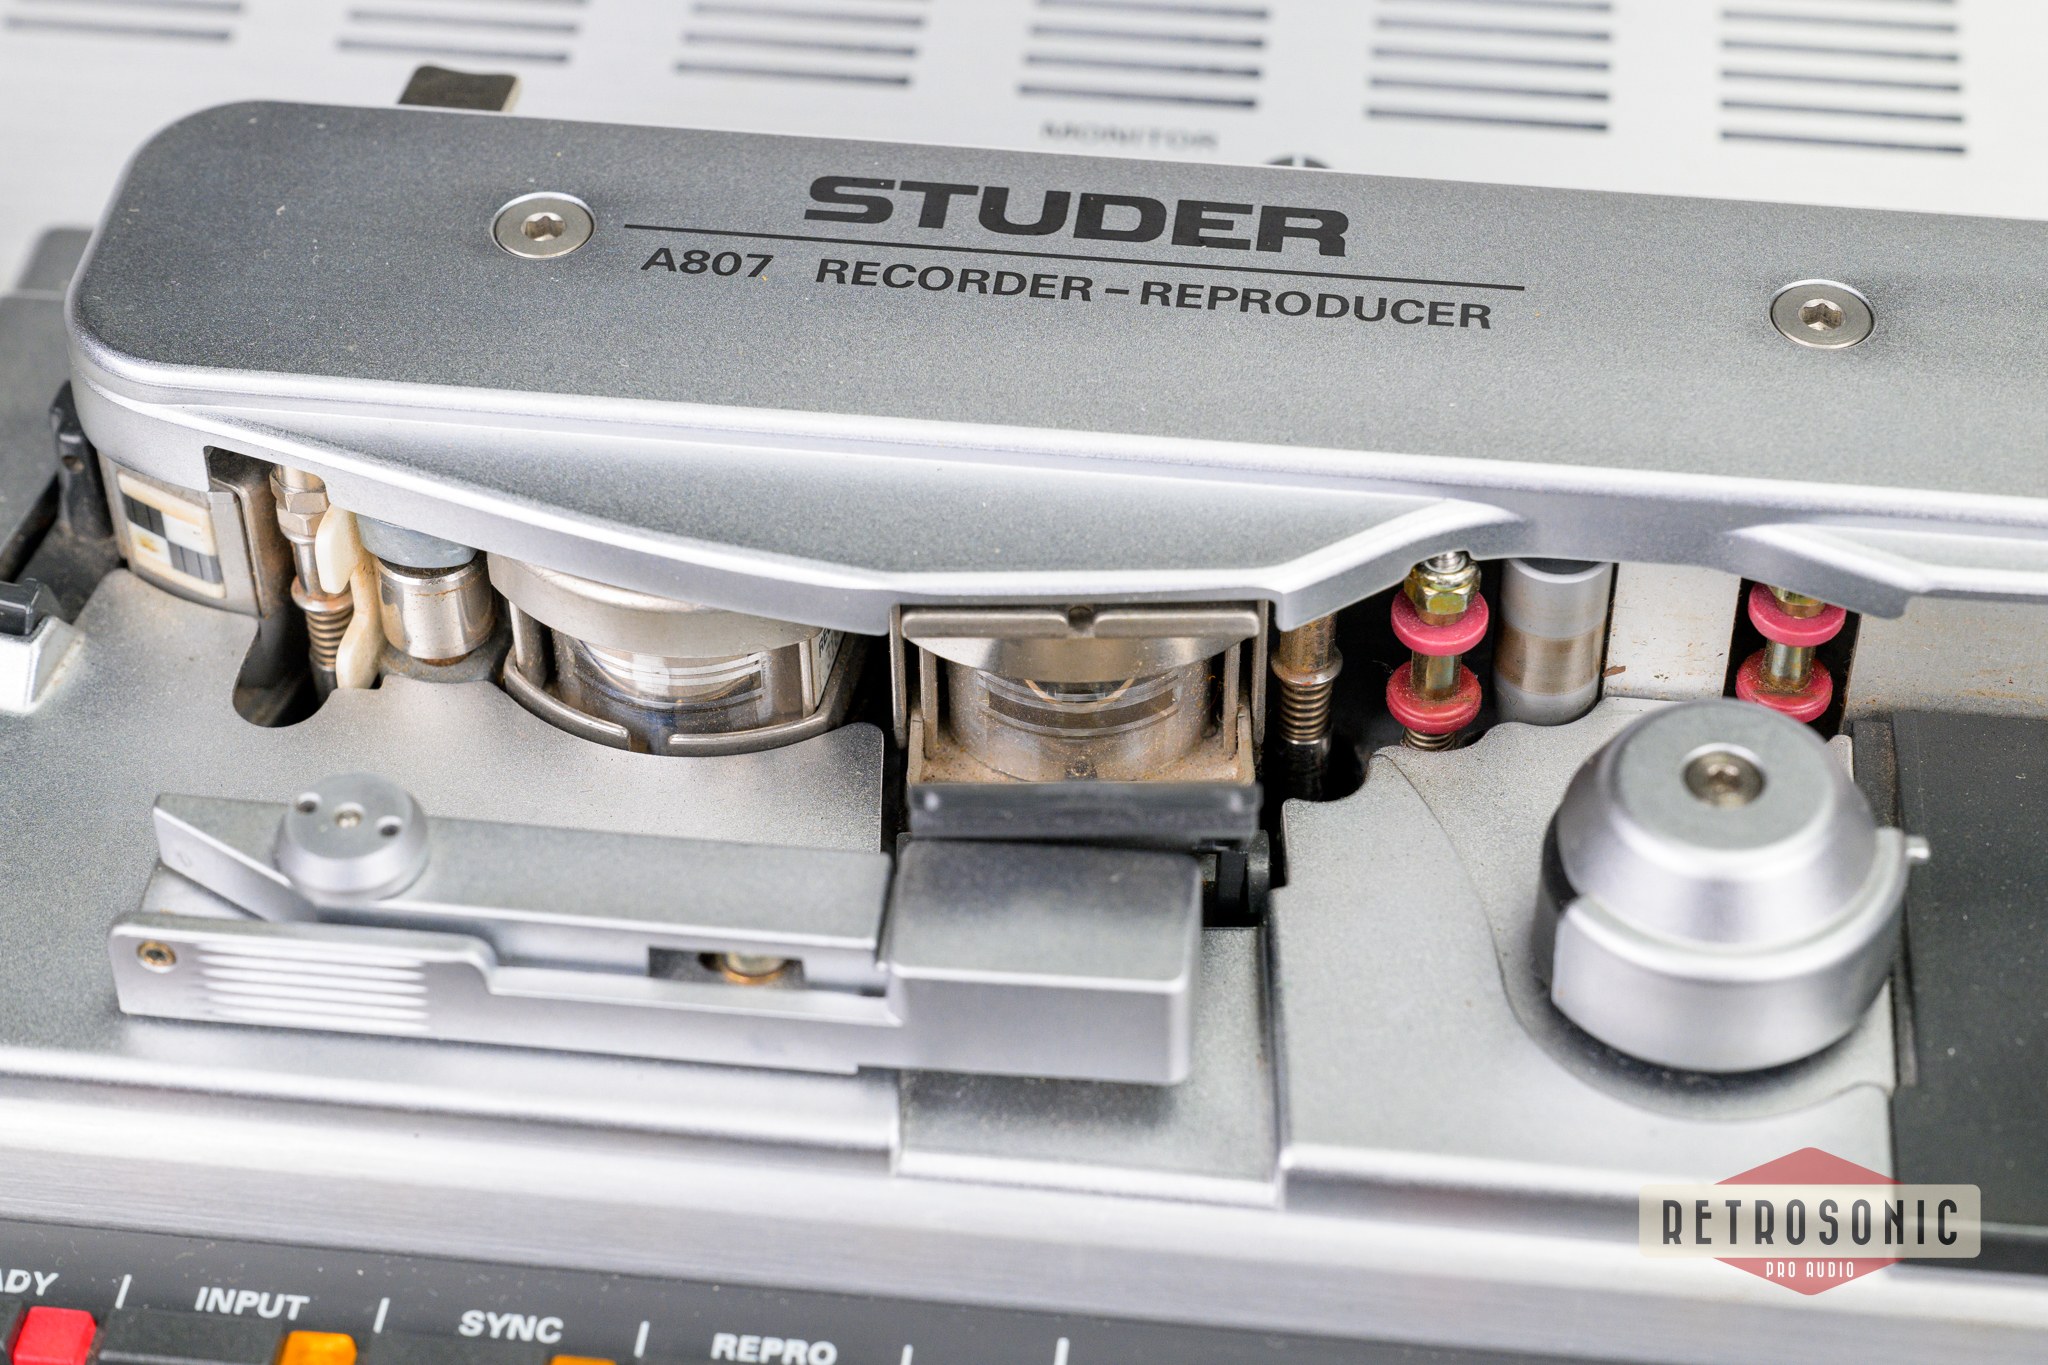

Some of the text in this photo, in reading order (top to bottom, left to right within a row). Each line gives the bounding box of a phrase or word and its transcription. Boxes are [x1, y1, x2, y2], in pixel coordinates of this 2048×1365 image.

[1040, 119, 1220, 150] MONITOR
[803, 174, 1349, 257] STUDER
[640, 246, 775, 279] A807
[815, 257, 1094, 303] RECORDER
[1139, 279, 1492, 331] REPRODUCER
[194, 1285, 311, 1321] INPUT
[457, 1309, 565, 1344] SYNC
[710, 1331, 838, 1365] REPRO
